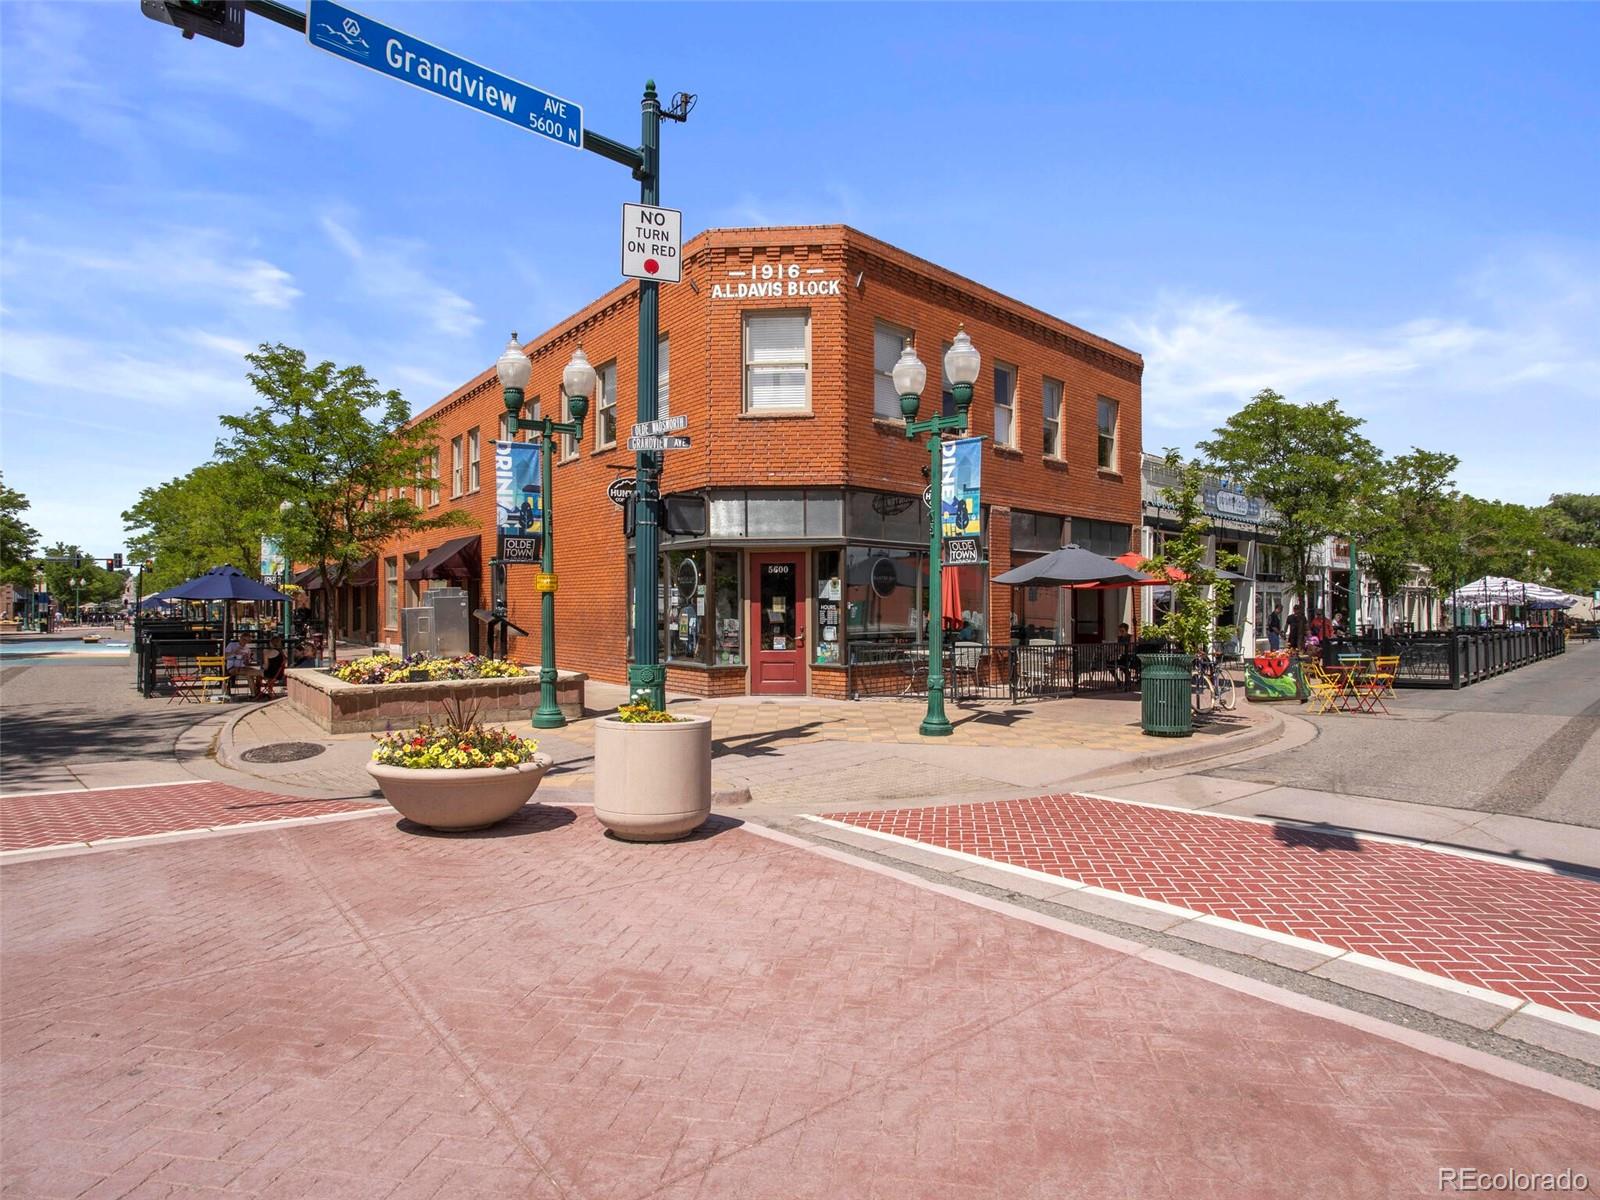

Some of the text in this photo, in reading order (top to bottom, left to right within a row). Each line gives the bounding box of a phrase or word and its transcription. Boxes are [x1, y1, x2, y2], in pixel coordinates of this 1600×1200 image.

[386, 38, 517, 114] Grandview
[543, 98, 567, 119] AVE
[529, 112, 577, 144] 5600 N
[641, 210, 666, 226] NO
[635, 227, 669, 242] TURN
[628, 241, 676, 257] ON RED
[752, 264, 800, 280] 1916
[788, 279, 840, 296] BLOCK
[632, 437, 668, 449] GRANDVIEW
[942, 444, 957, 503] DINE
[505, 548, 533, 557] TOWN
[507, 540, 532, 549] OLDE
[951, 541, 974, 551] OLDE
[951, 550, 976, 559] TOWN
[768, 565, 789, 574] 5600
